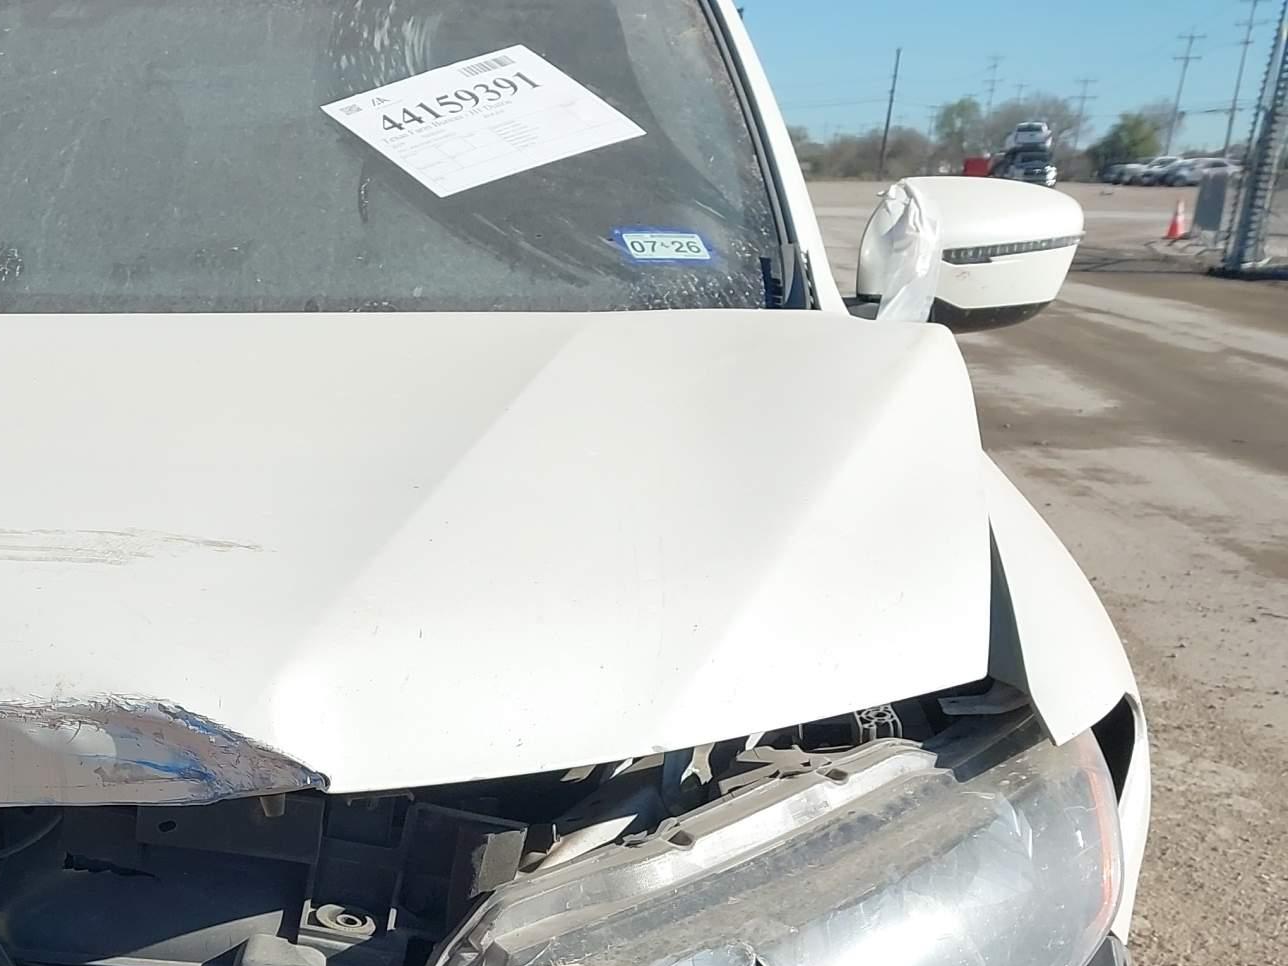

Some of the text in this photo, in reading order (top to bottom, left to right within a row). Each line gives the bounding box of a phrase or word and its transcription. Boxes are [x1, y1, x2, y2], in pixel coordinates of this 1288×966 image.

[382, 71, 542, 131] 44159391
[630, 240, 701, 254] 07 26
